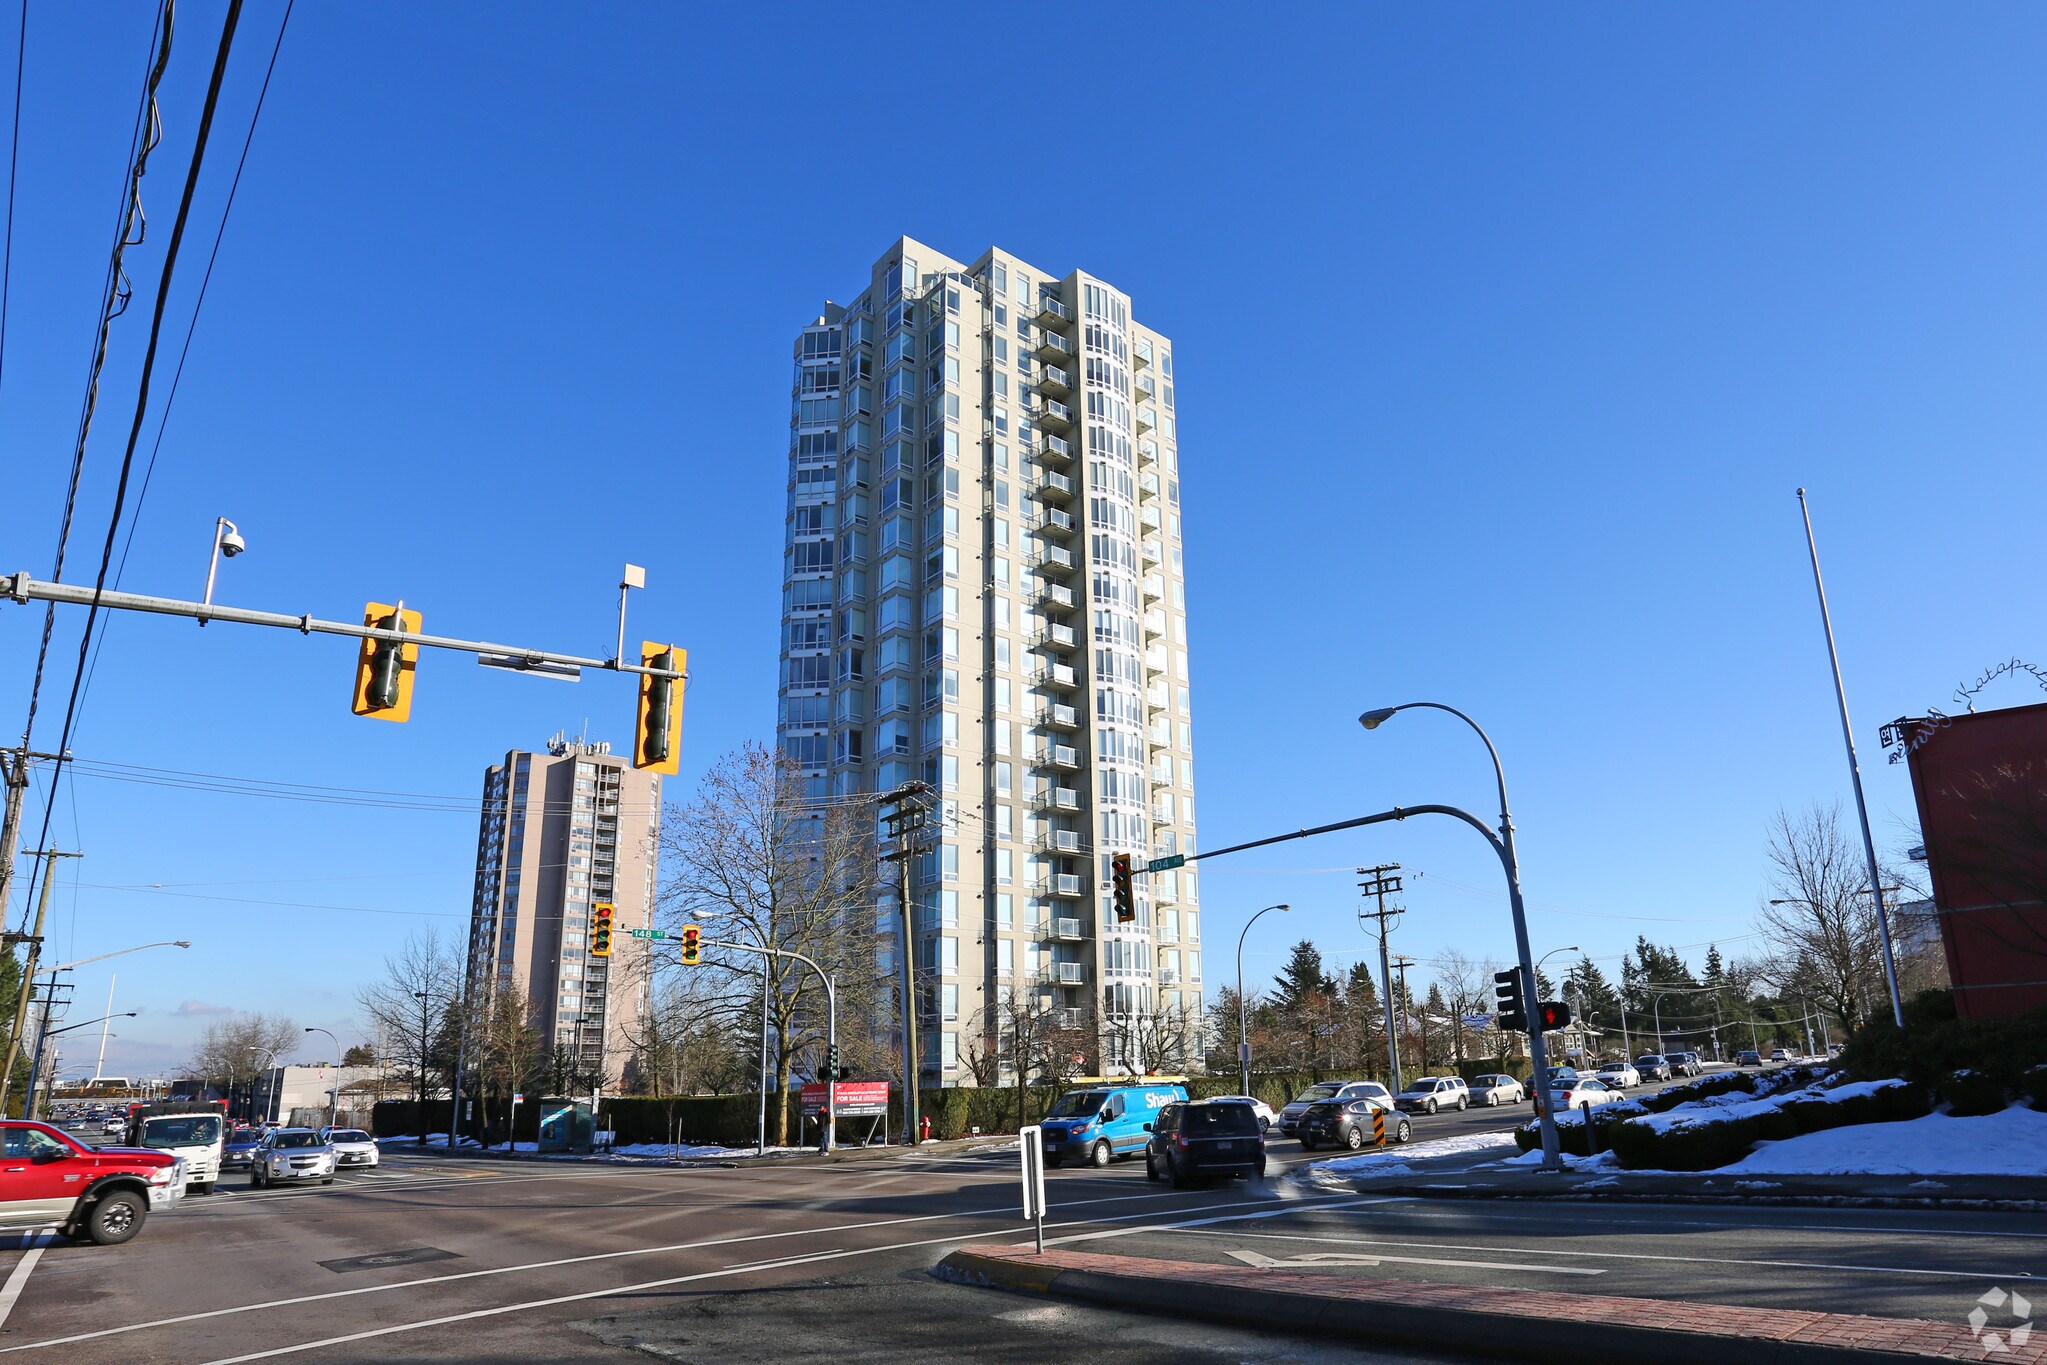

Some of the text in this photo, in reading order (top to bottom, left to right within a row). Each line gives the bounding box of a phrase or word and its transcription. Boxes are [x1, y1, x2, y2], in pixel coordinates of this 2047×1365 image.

[1150, 859, 1169, 871] 104
[634, 930, 652, 938] 148
[1145, 1089, 1180, 1109] Shaw
